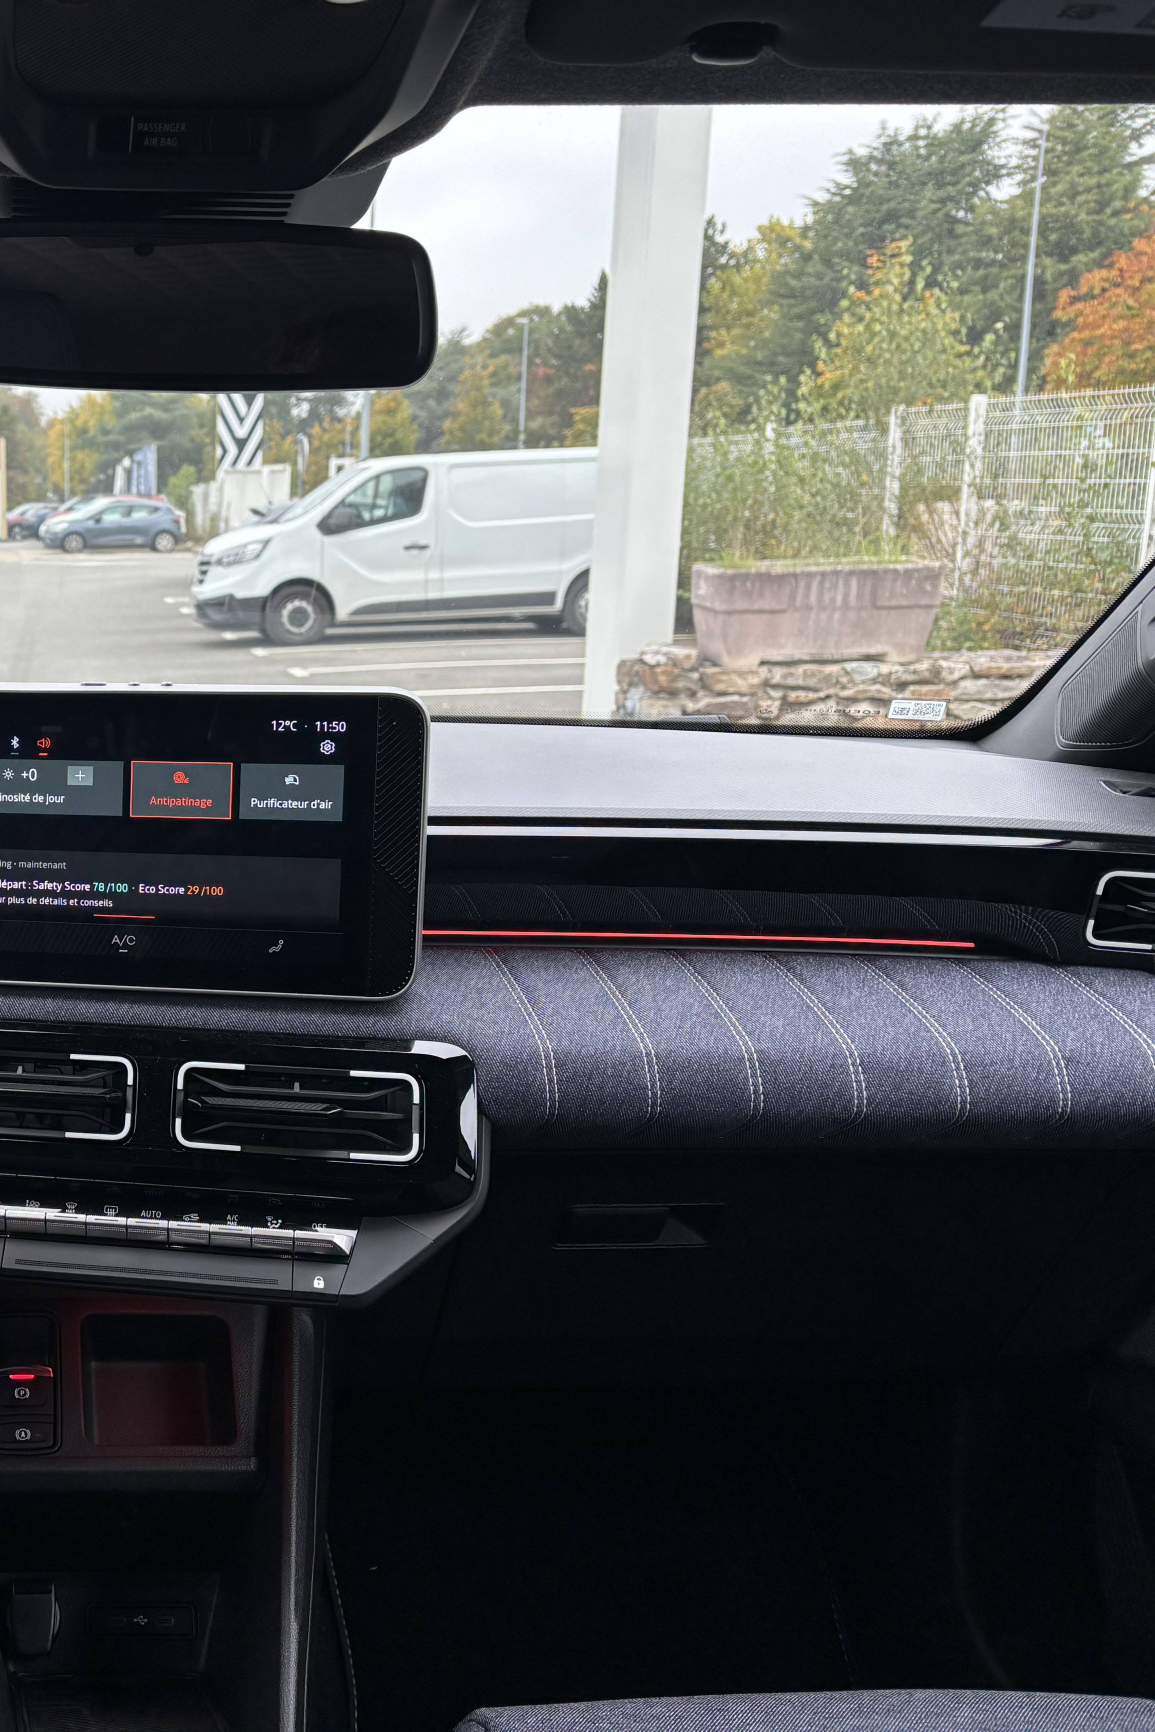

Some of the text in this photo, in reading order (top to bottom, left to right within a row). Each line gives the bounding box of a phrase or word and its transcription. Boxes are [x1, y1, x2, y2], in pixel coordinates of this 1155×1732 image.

[137, 122, 186, 133] PASSENGER
[143, 137, 178, 147] AIR BAG
[271, 720, 346, 732] 12°C 11:50
[21, 768, 38, 781] +0
[32, 793, 44, 803] de
[45, 793, 65, 805] jour
[149, 796, 213, 809] Antipatinage
[250, 797, 333, 809] Purificateur d'air
[18, 860, 67, 870] maintenant
[32, 880, 63, 893] Safety
[64, 881, 91, 892] Score
[93, 882, 105, 892] 78
[138, 884, 156, 894] Eco
[158, 884, 185, 895] Score
[187, 885, 200, 895] 29
[7, 895, 25, 905] plus
[27, 895, 38, 905] de
[39, 896, 67, 906] détails
[69, 898, 78, 906] et
[80, 898, 113, 907] conseils
[111, 934, 136, 947] A/C
[140, 1210, 162, 1218] AUTO
[226, 1214, 239, 1222] A/C
[311, 1222, 327, 1230] OFF
